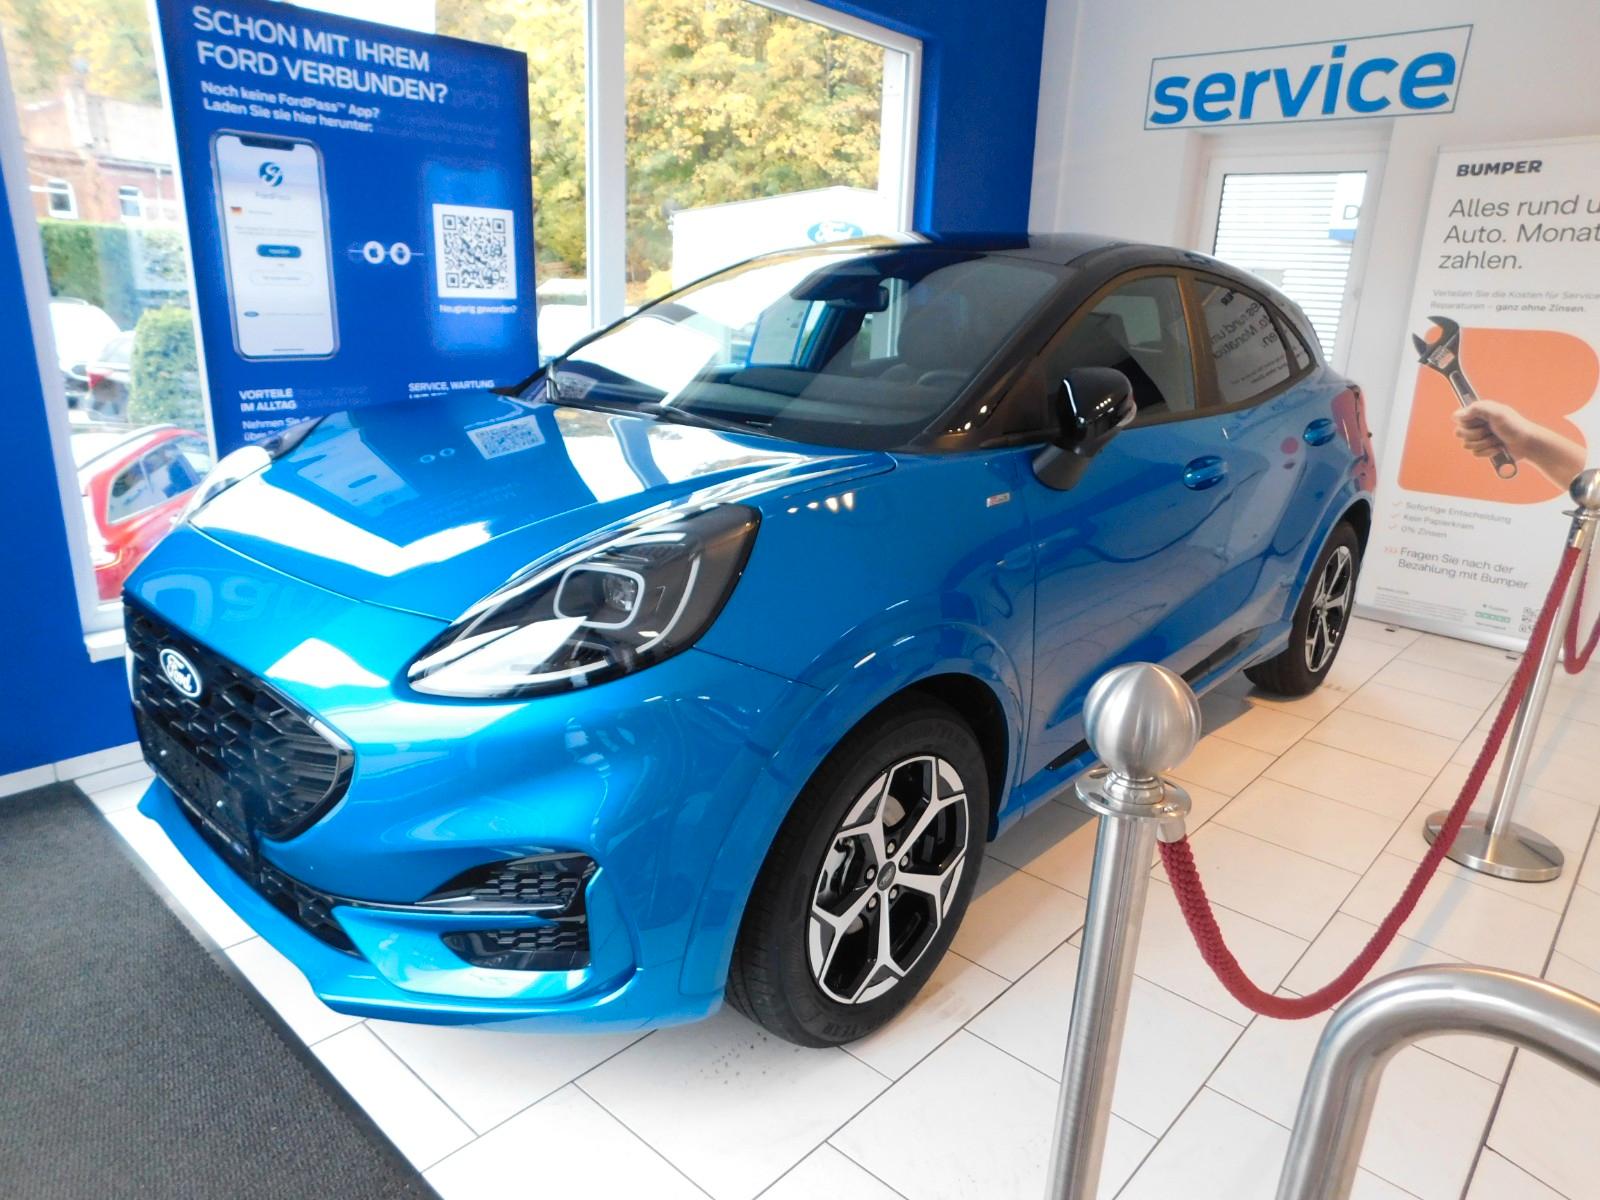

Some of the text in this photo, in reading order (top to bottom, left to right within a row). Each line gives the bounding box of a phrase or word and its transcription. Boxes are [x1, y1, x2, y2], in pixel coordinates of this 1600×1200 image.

[192, 5, 430, 72] SCHON MIT IHREM
[197, 40, 448, 104] FORD VERBUNDEN?
[1149, 44, 1456, 124] service
[200, 80, 239, 98] Noch
[240, 86, 277, 104] keine
[348, 104, 380, 119] App?
[203, 97, 247, 115] Laden
[249, 104, 271, 119] Sie
[273, 107, 292, 121] sie
[293, 110, 317, 125] hier
[1456, 159, 1543, 178] BUMPER
[1448, 198, 1510, 218] Alles
[1516, 194, 1580, 217] rund
[1443, 225, 1507, 244] Auto.
[1438, 250, 1523, 270] zahlen.
[1495, 303, 1519, 312] ganz
[1521, 303, 1546, 312] ohne
[239, 388, 293, 400] VORTEILE
[408, 380, 496, 392] SERVICE, WARTUNG
[240, 400, 297, 412] IM ALLTAG
[1400, 546, 1514, 574] Fragen Sie nach der
[1398, 558, 1528, 589] Bezahlung mit Bumper
[167, 654, 192, 692] Ford
